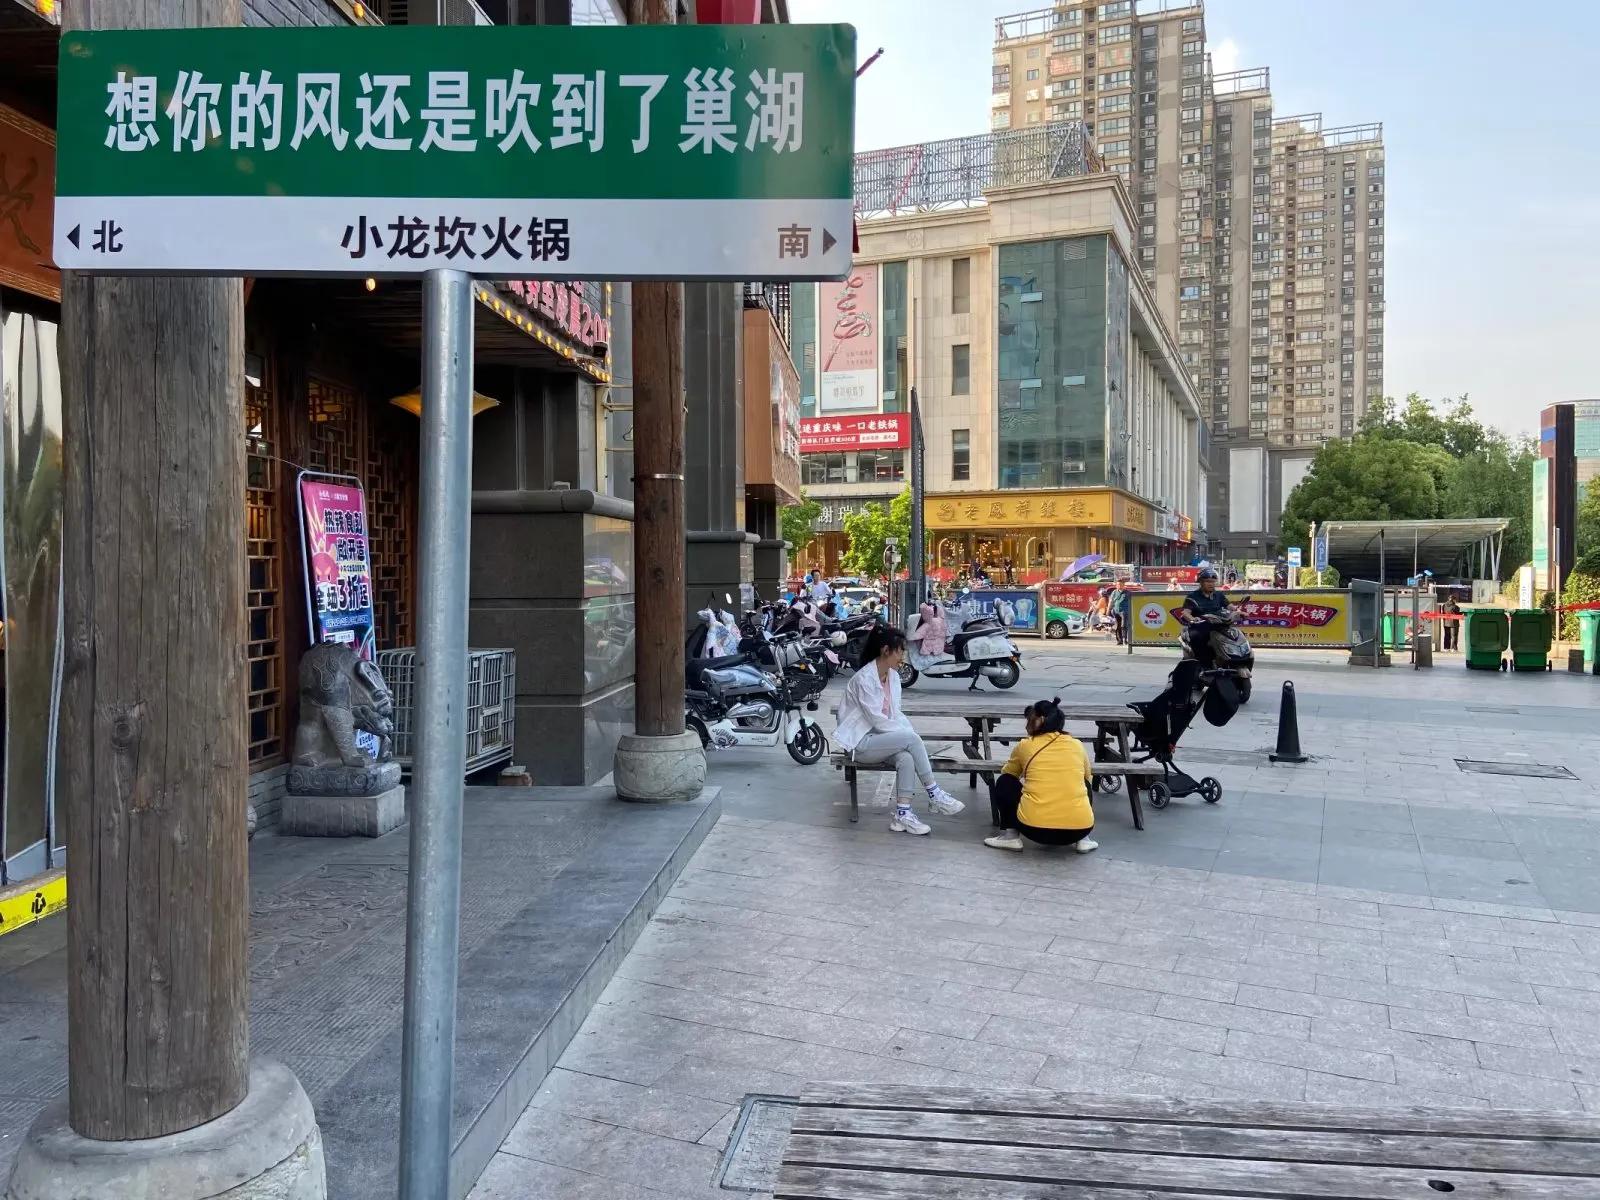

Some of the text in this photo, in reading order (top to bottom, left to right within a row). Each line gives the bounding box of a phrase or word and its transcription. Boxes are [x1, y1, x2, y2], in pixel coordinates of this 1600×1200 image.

[104, 67, 804, 154] 想你的风还是吹到了巢湖
[92, 220, 124, 253] 北
[340, 215, 570, 262] 小龙坎火锅
[777, 222, 812, 259] 南
